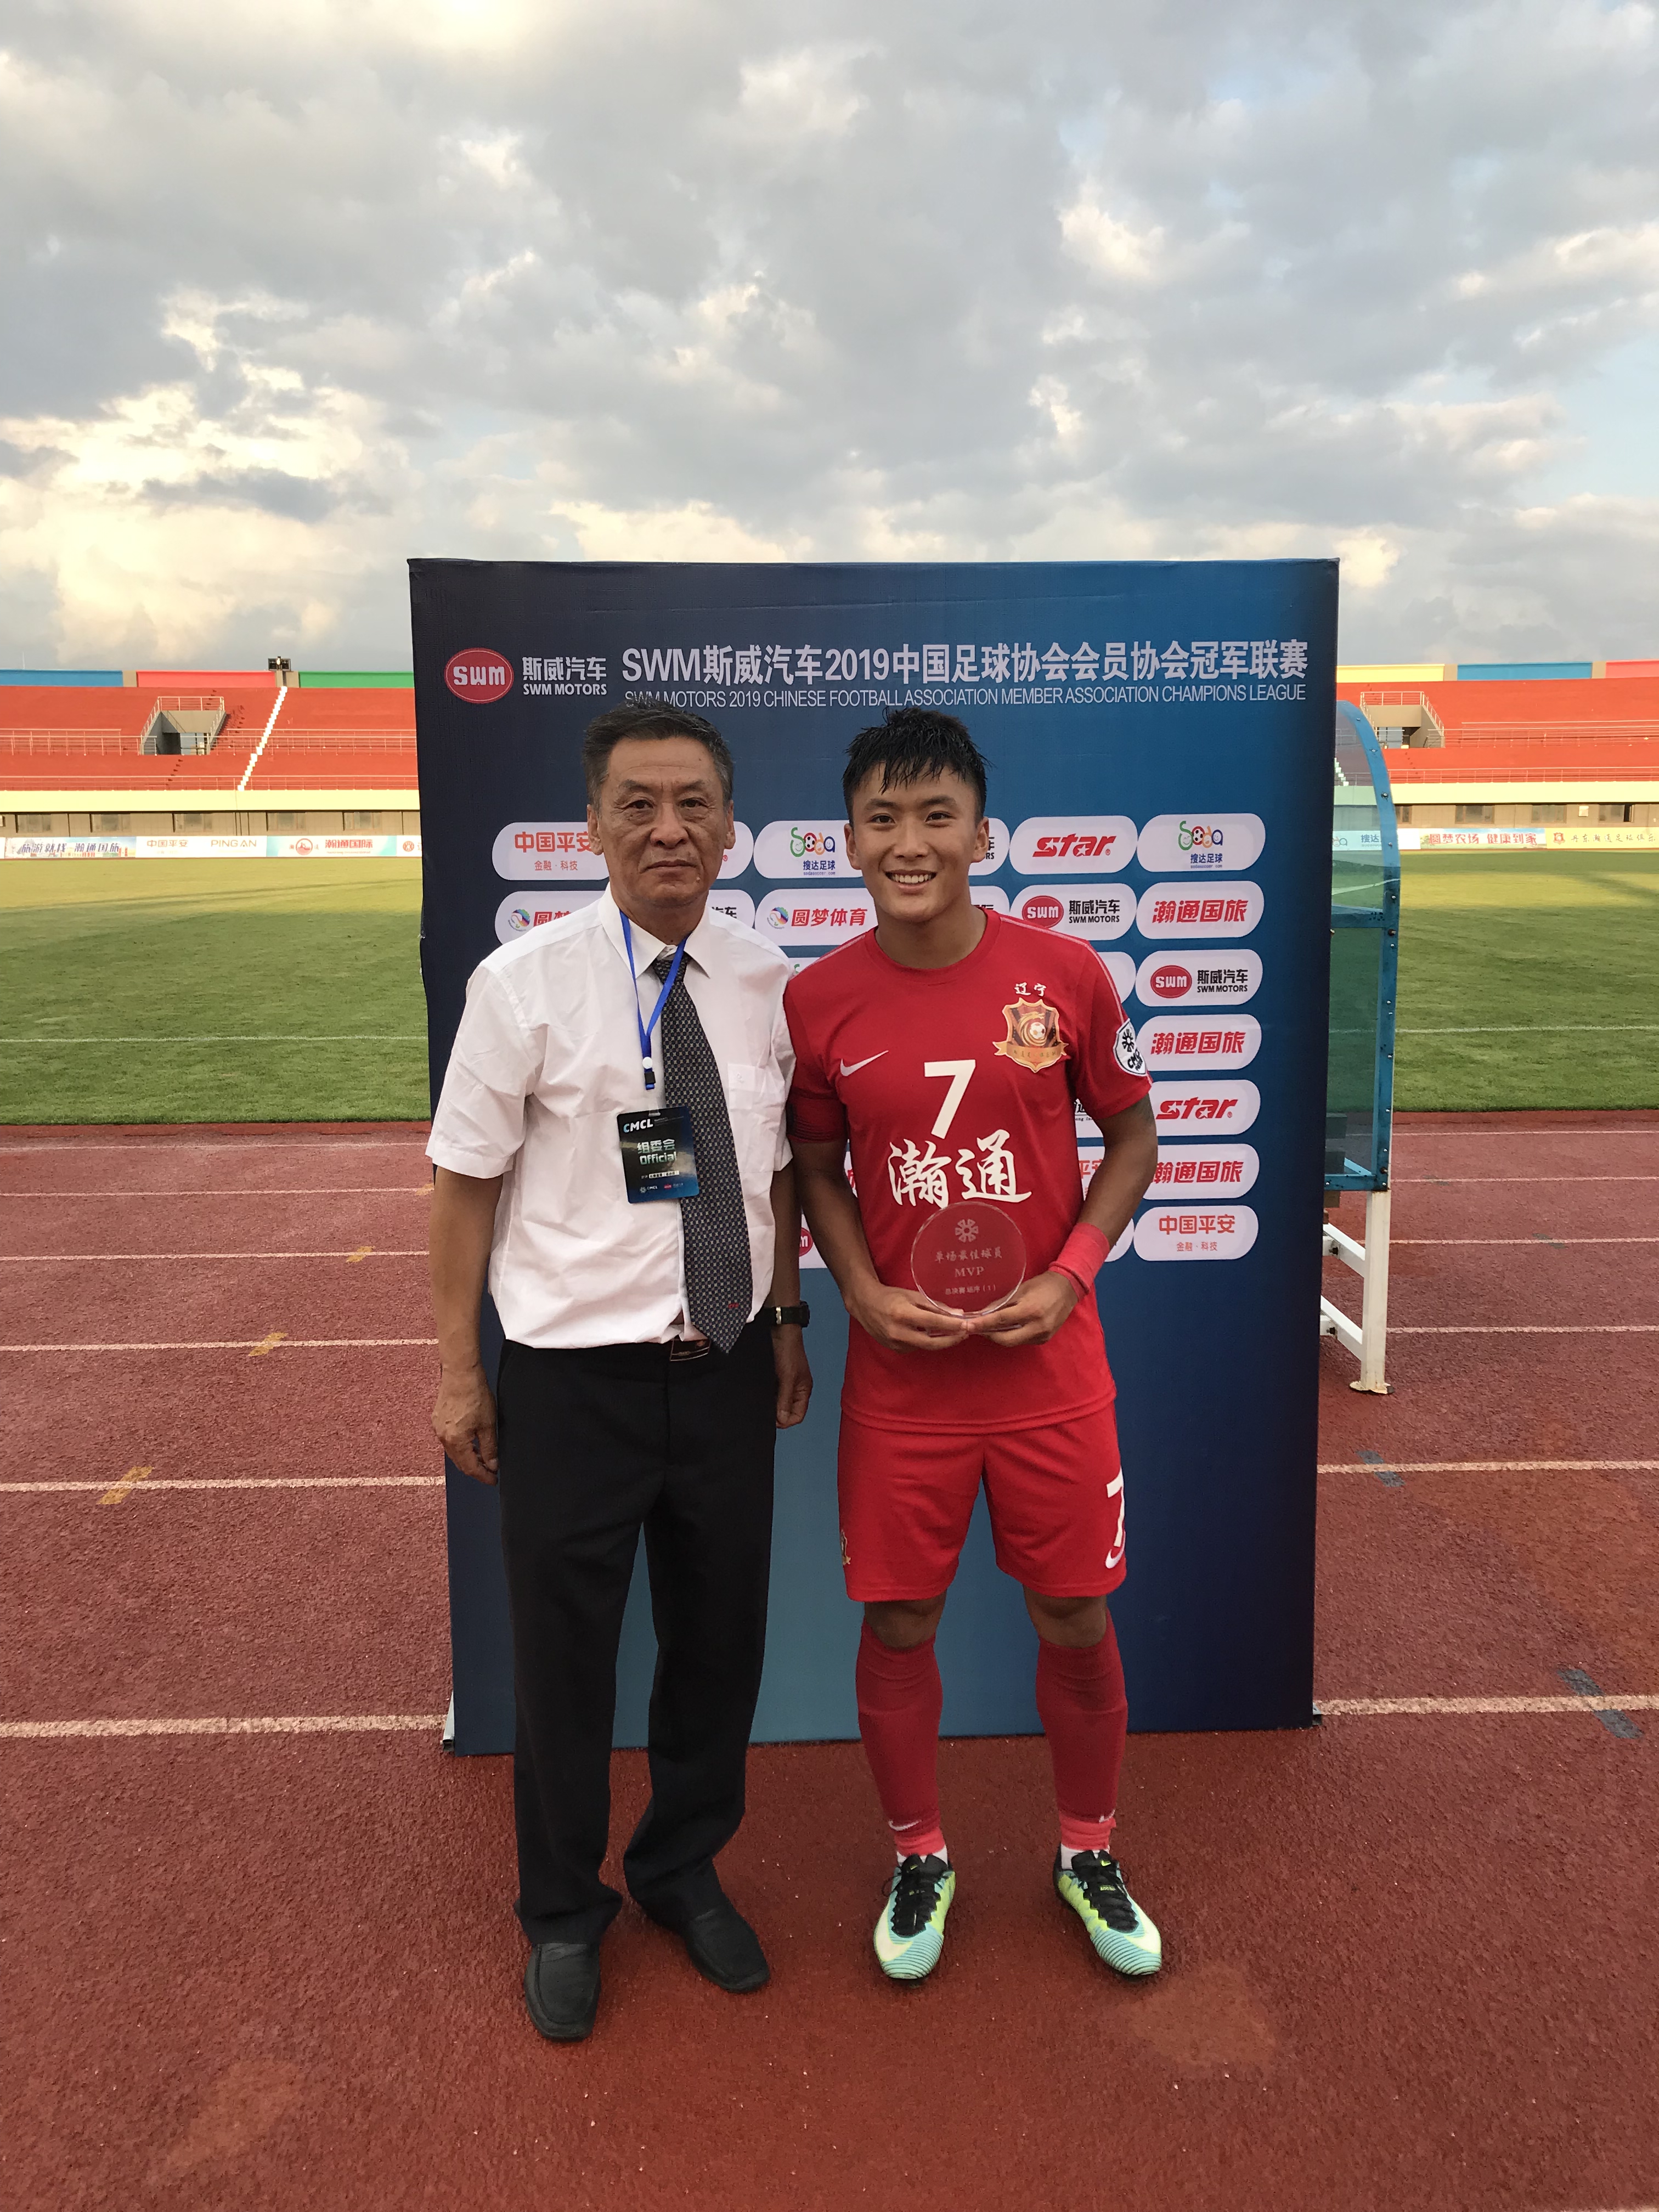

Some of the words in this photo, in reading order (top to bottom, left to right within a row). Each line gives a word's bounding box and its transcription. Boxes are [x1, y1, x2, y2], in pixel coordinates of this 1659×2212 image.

[522, 657, 607, 680] 斯威汽车
[523, 684, 552, 696] SWM
[555, 684, 607, 696] MOTORS
[664, 690, 725, 708] MOTORS
[729, 690, 760, 708] 2019
[764, 690, 826, 707] CHINESE
[830, 689, 903, 707] FOOTBALL
[904, 688, 998, 706] ASSOCIATION
[1001, 687, 1063, 704] MEMBER
[1065, 686, 1159, 703] ASSOCIATION
[1161, 685, 1247, 702] CHAMPIONS
[1249, 684, 1306, 701] LEAGUE
[803, 860, 836, 871] 搜达足球
[1190, 854, 1223, 864] 搜达足球
[1069, 900, 1120, 915] 斯威汽车
[1152, 900, 1249, 923] 瀚通国旅
[791, 909, 867, 927] 圆梦体育
[1197, 969, 1248, 984] 斯威汽车
[1014, 982, 1047, 997] 辽宁
[1150, 1032, 1246, 1054] 瀚通国旅
[924, 1059, 976, 1139] 7
[623, 1119, 653, 1133] CMCL
[640, 1152, 677, 1165] Official
[888, 1129, 1031, 1209] 瀚通
[1159, 1214, 1235, 1234] 中国平安
[955, 1266, 985, 1277] MVP
